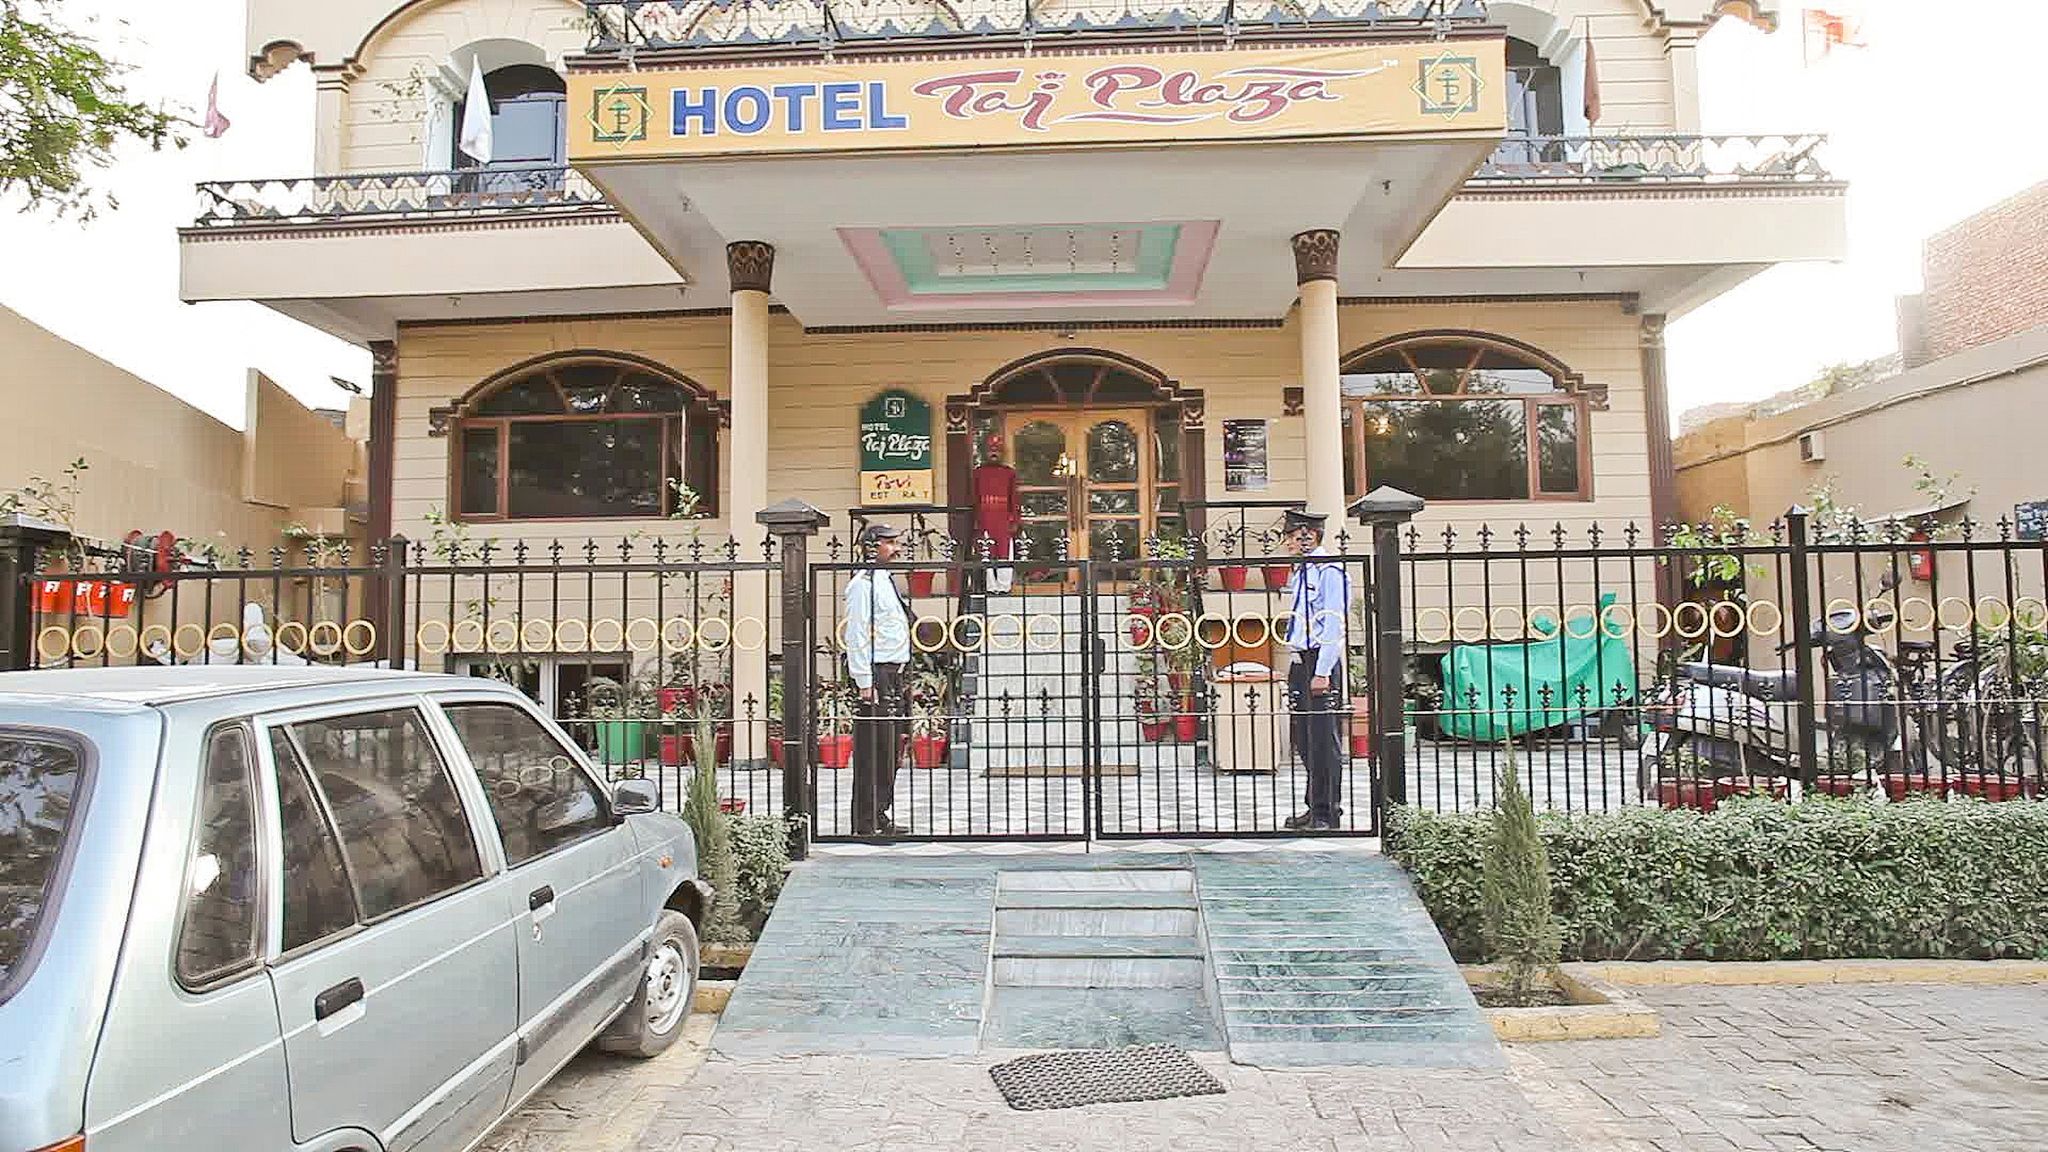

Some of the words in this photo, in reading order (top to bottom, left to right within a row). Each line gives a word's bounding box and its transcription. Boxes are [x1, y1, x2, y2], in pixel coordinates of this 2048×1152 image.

[671, 82, 908, 136] HOTEL
[913, 69, 1062, 131] Taj
[1084, 65, 1342, 122] Plaza
[861, 422, 891, 431] HOTEL
[861, 432, 887, 461] Taj
[887, 433, 931, 461] Plaza
